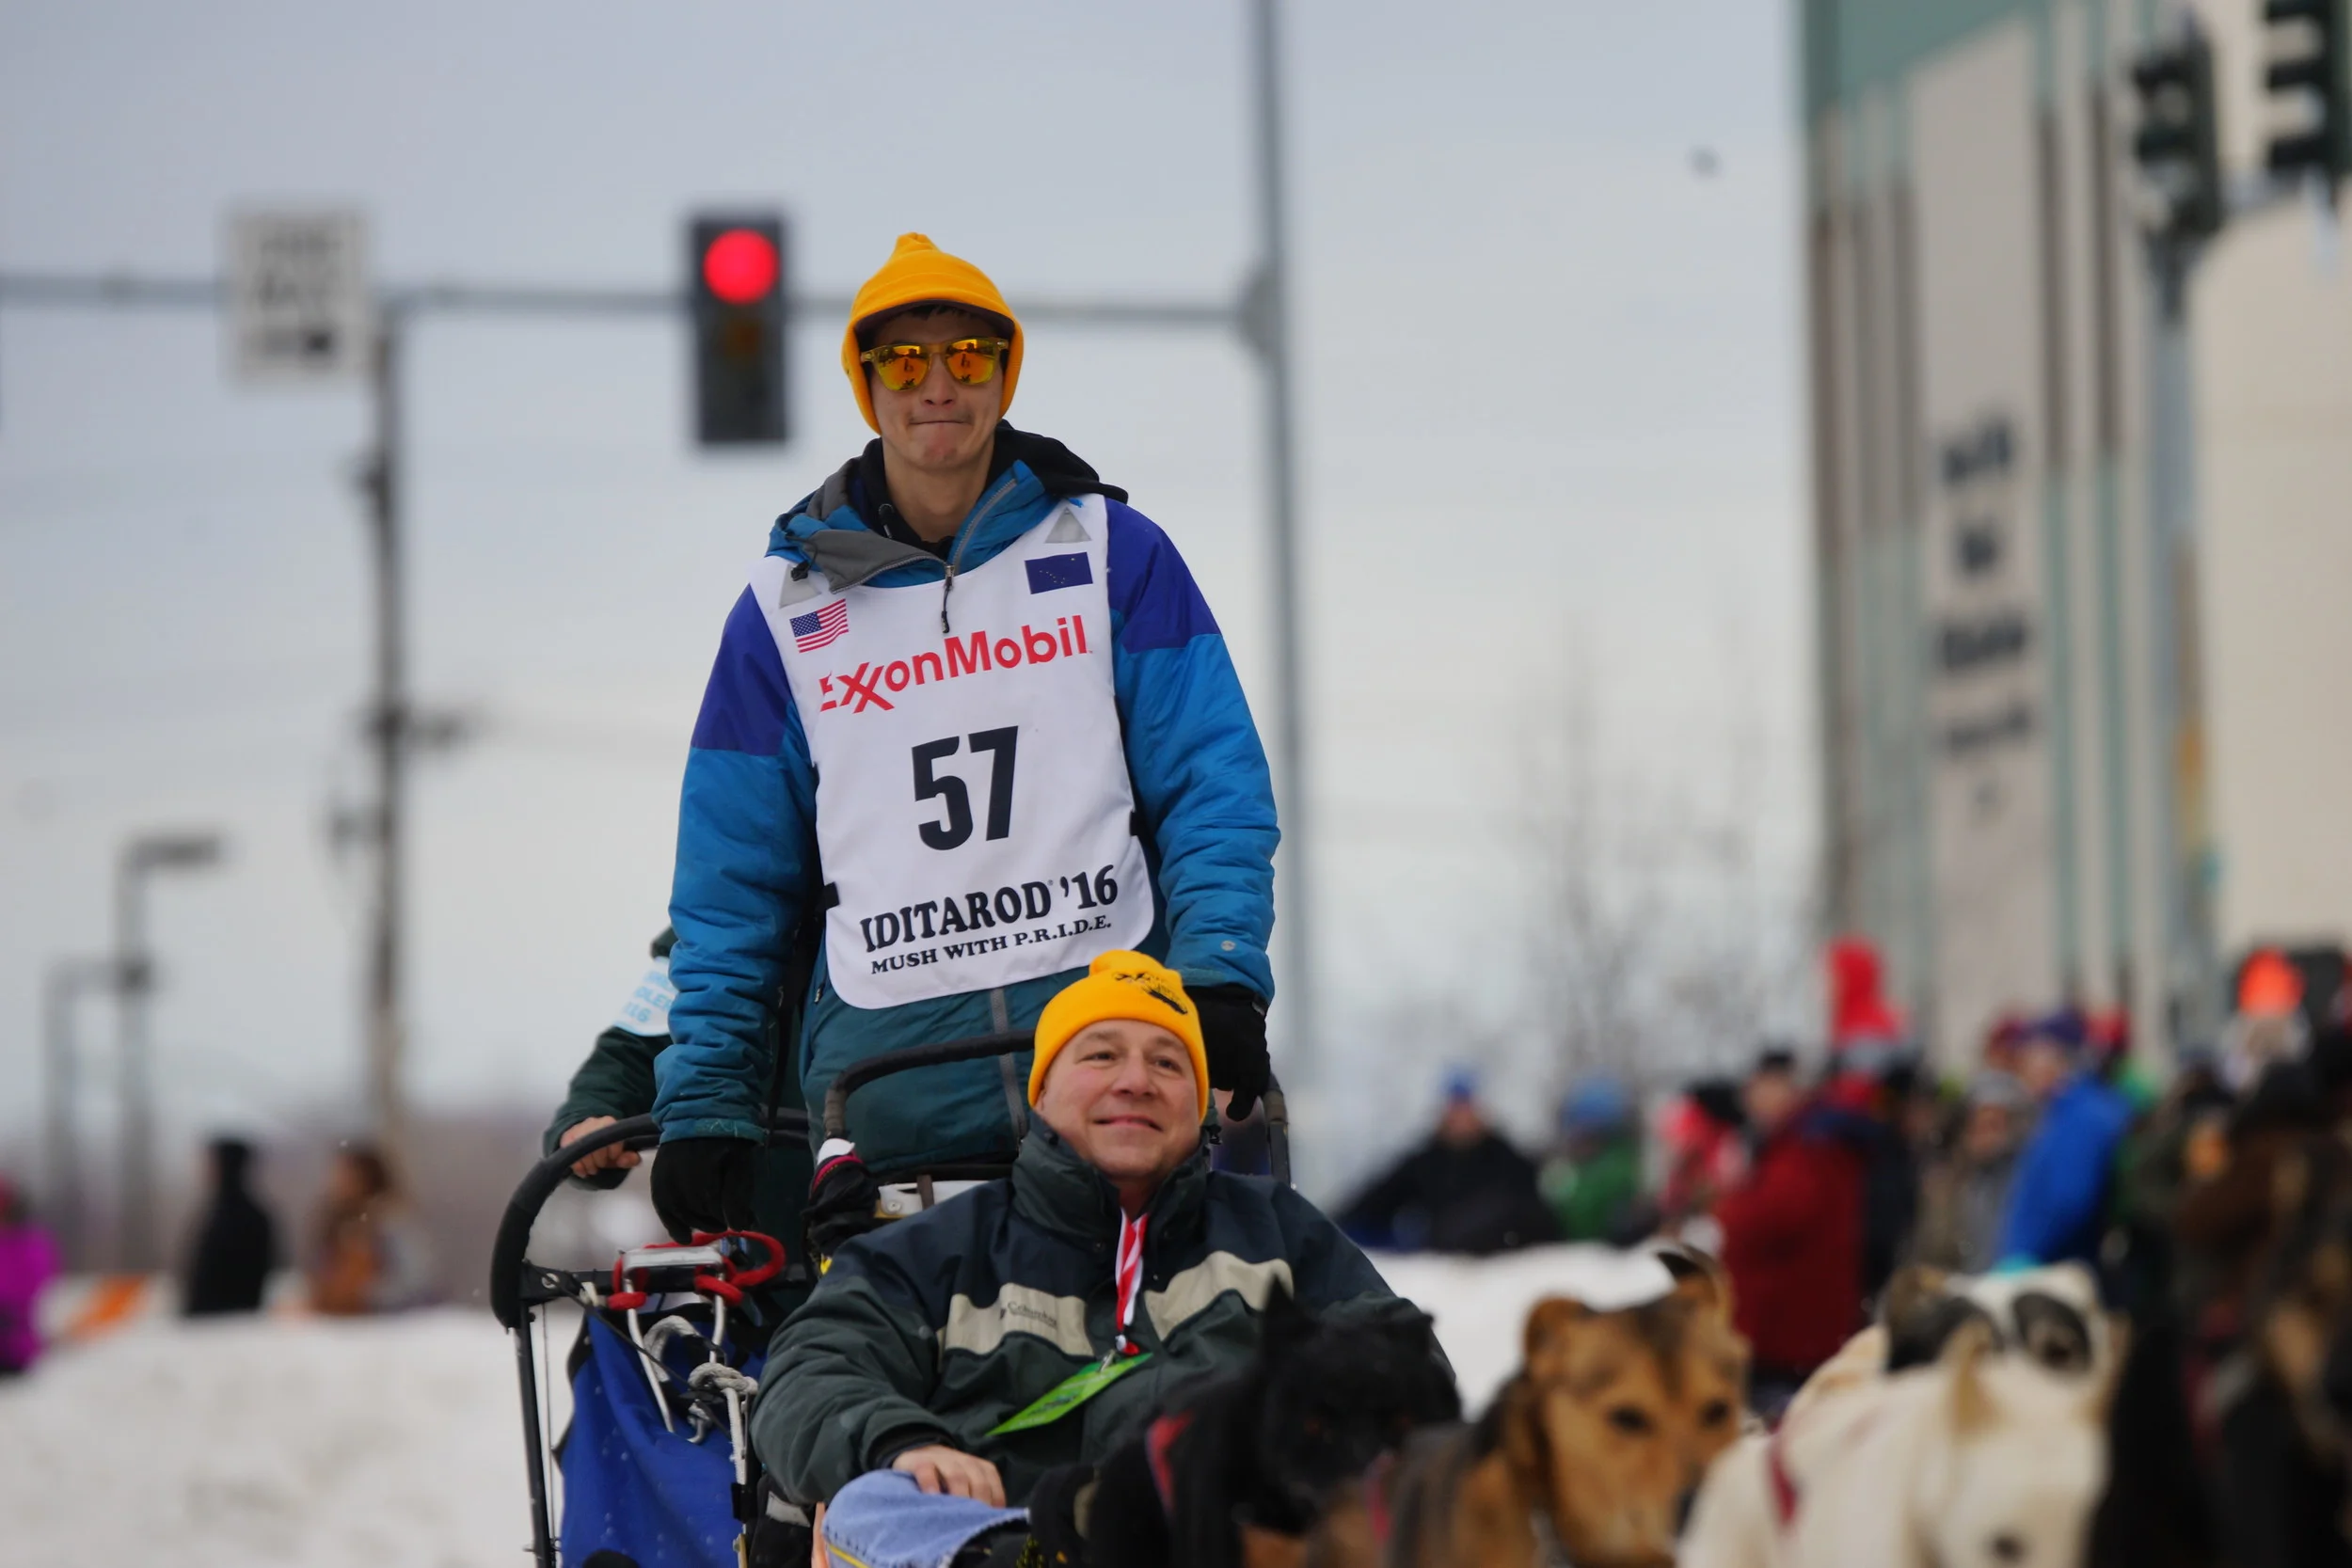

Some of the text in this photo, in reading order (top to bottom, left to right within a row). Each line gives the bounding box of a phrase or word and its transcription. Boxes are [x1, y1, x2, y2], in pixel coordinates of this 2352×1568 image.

[911, 724, 1019, 851] 57
[860, 863, 1119, 954] IDITAROD '16
[871, 914, 1112, 975] MUSH WITH P.R.I.D.E.
